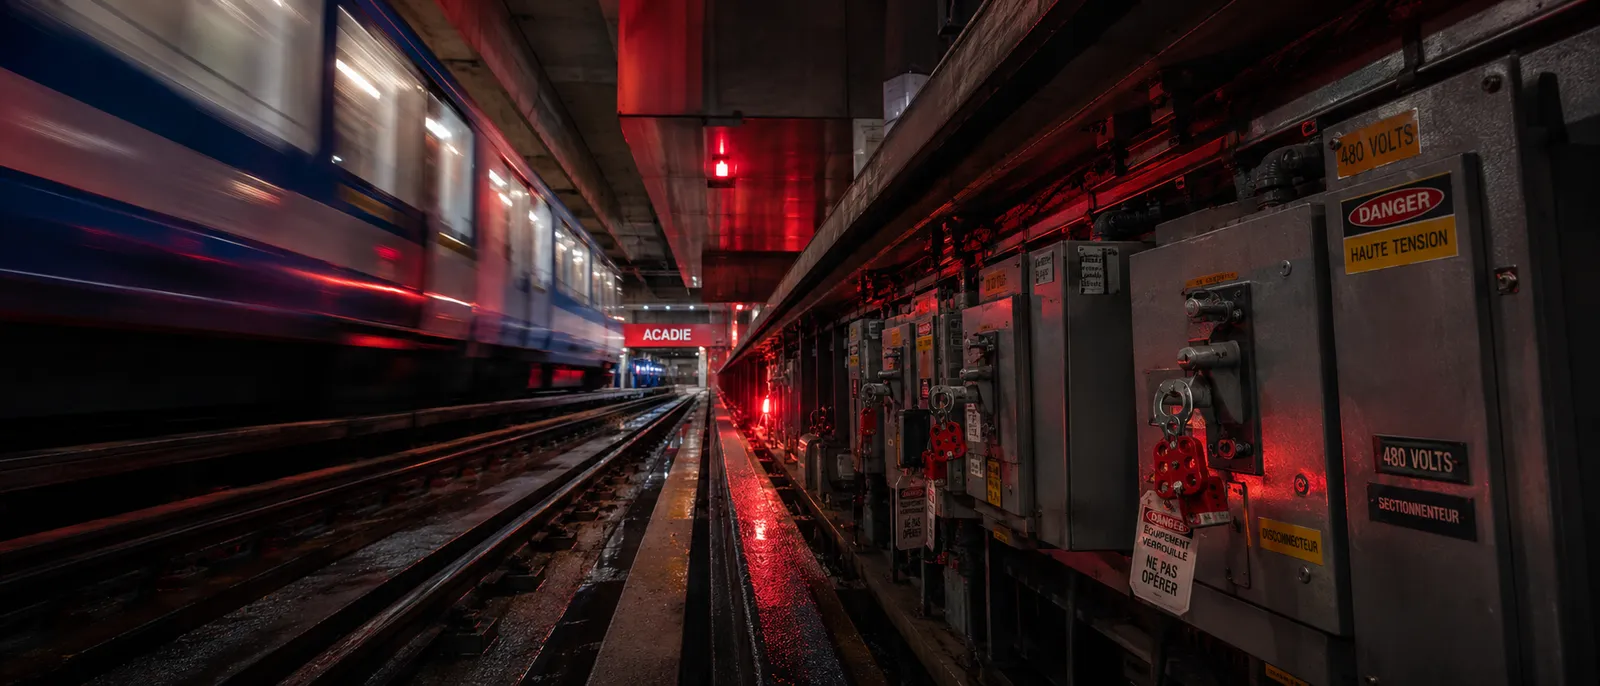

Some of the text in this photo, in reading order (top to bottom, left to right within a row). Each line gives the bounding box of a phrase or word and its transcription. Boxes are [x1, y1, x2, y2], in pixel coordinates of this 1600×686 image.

[1340, 123, 1414, 166] 480 VOLTS
[1358, 191, 1431, 223] DANGER
[1351, 229, 1449, 263] HAUTE TENSION
[643, 328, 692, 341] ACADIE
[1383, 447, 1453, 473] 480 VOLTS
[1378, 497, 1460, 524] SECTIONNENTEUR
[1262, 527, 1319, 554] DISCONNECTEUR
[1146, 554, 1178, 579] NE PAS
[1142, 570, 1178, 596] OPÉRER
